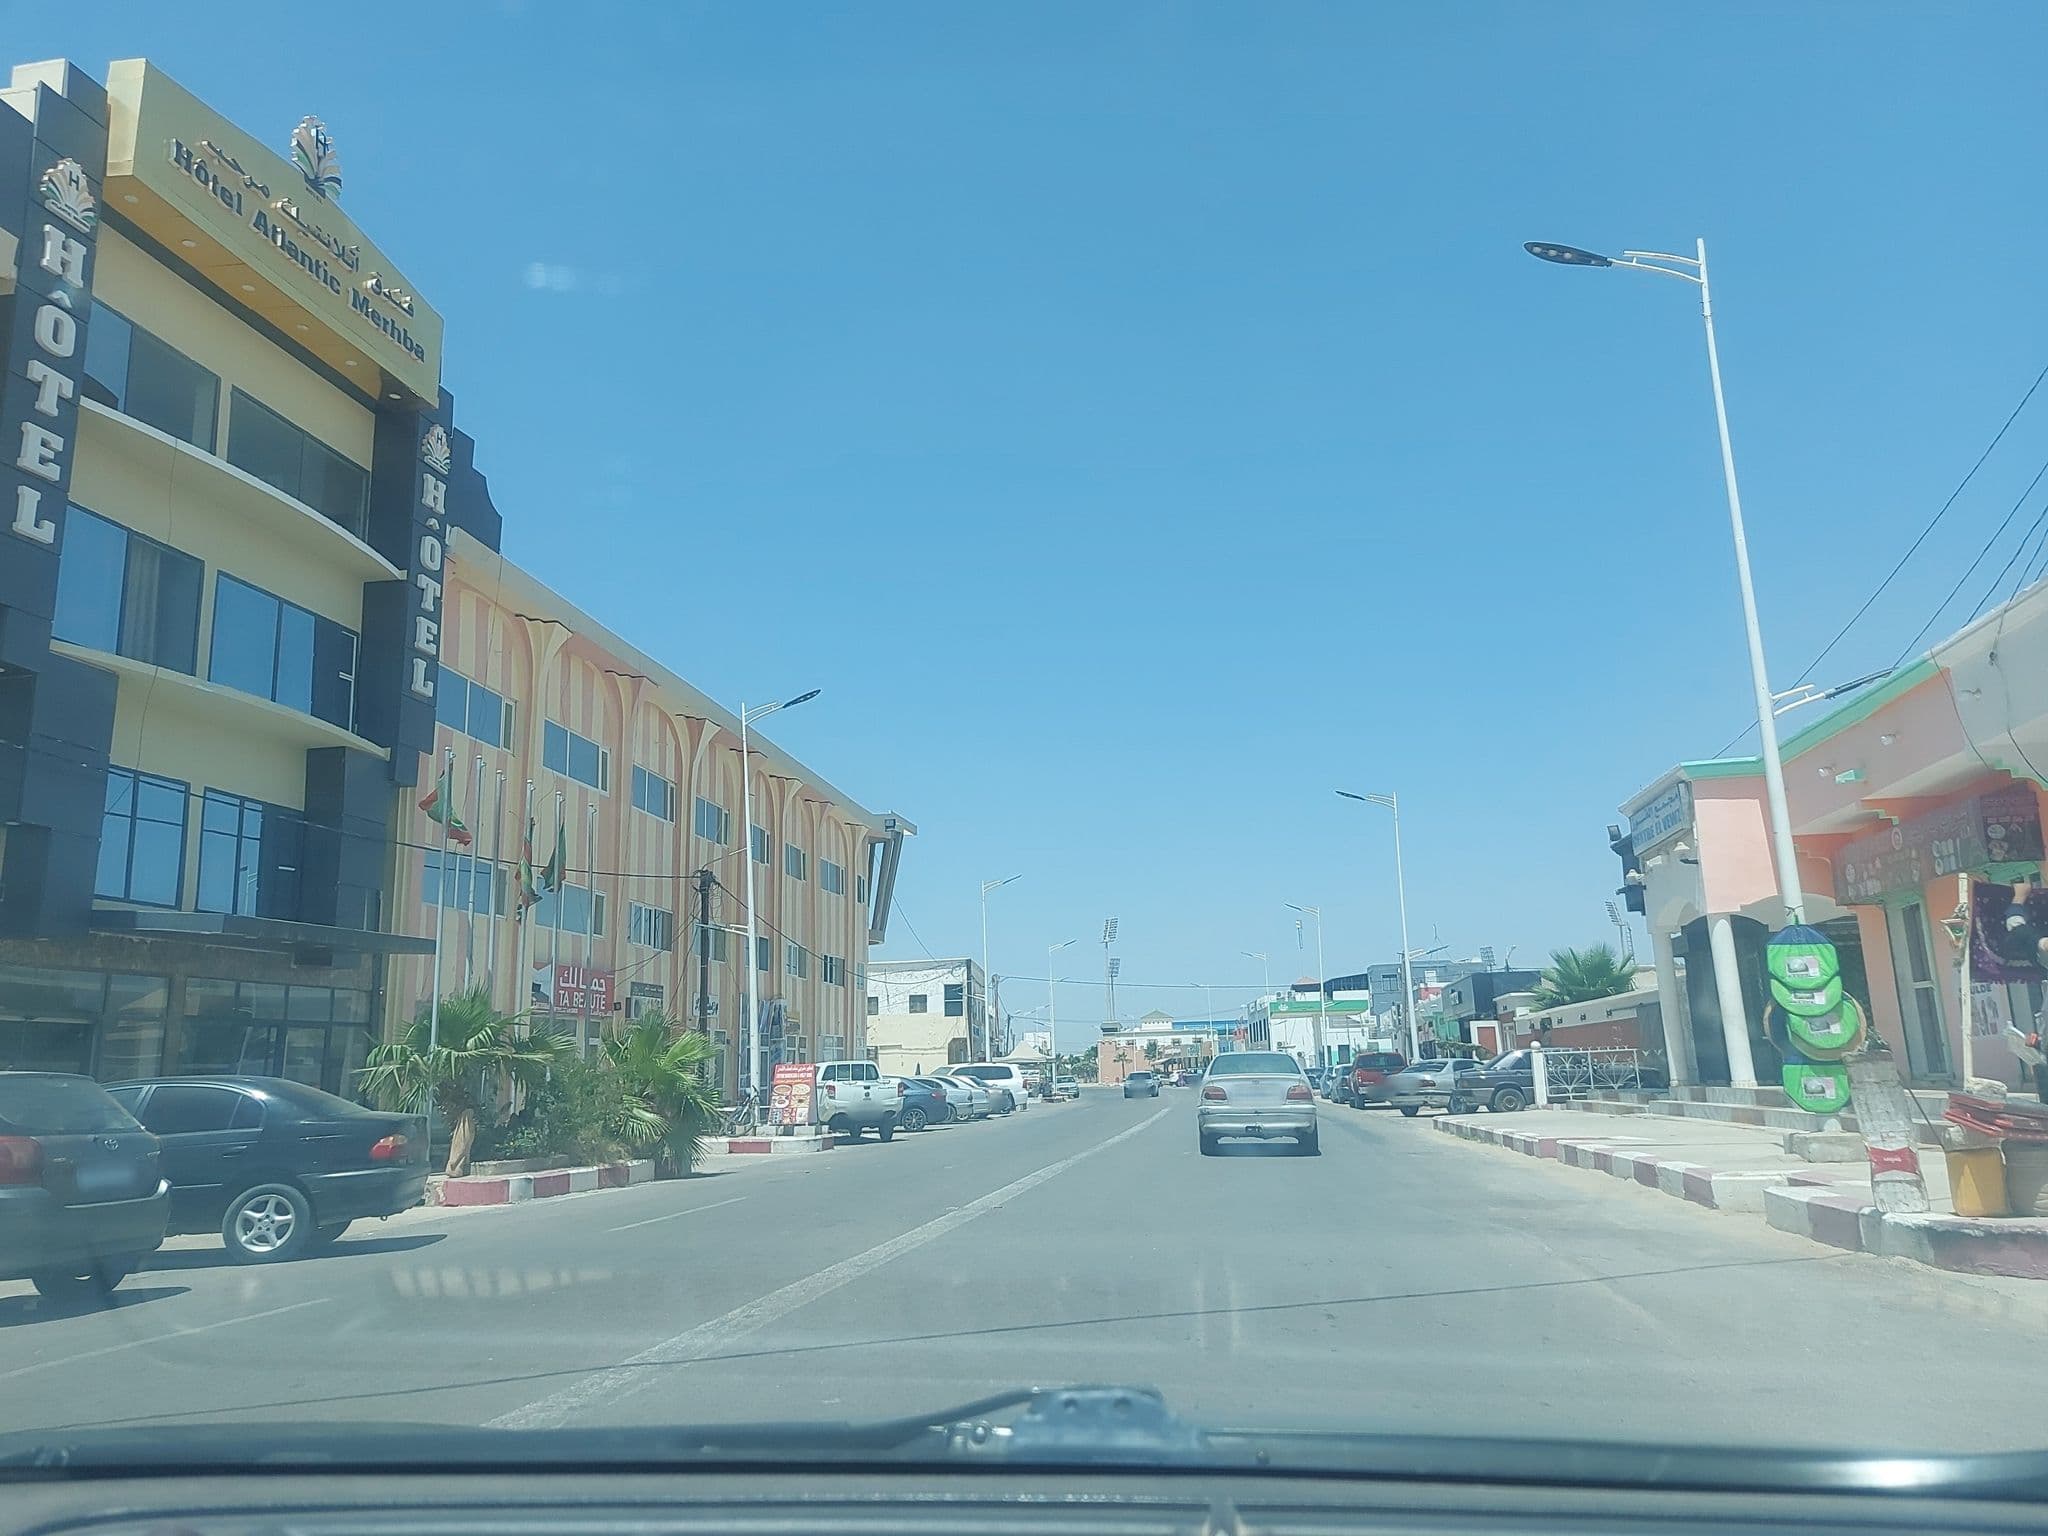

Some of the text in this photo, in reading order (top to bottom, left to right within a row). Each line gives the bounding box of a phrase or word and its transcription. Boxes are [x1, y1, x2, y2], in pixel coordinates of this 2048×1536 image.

[168, 138, 425, 363] Hôtel Atlantic Merhba
[364, 271, 414, 319] فندق
[559, 989, 569, 1006] TA
